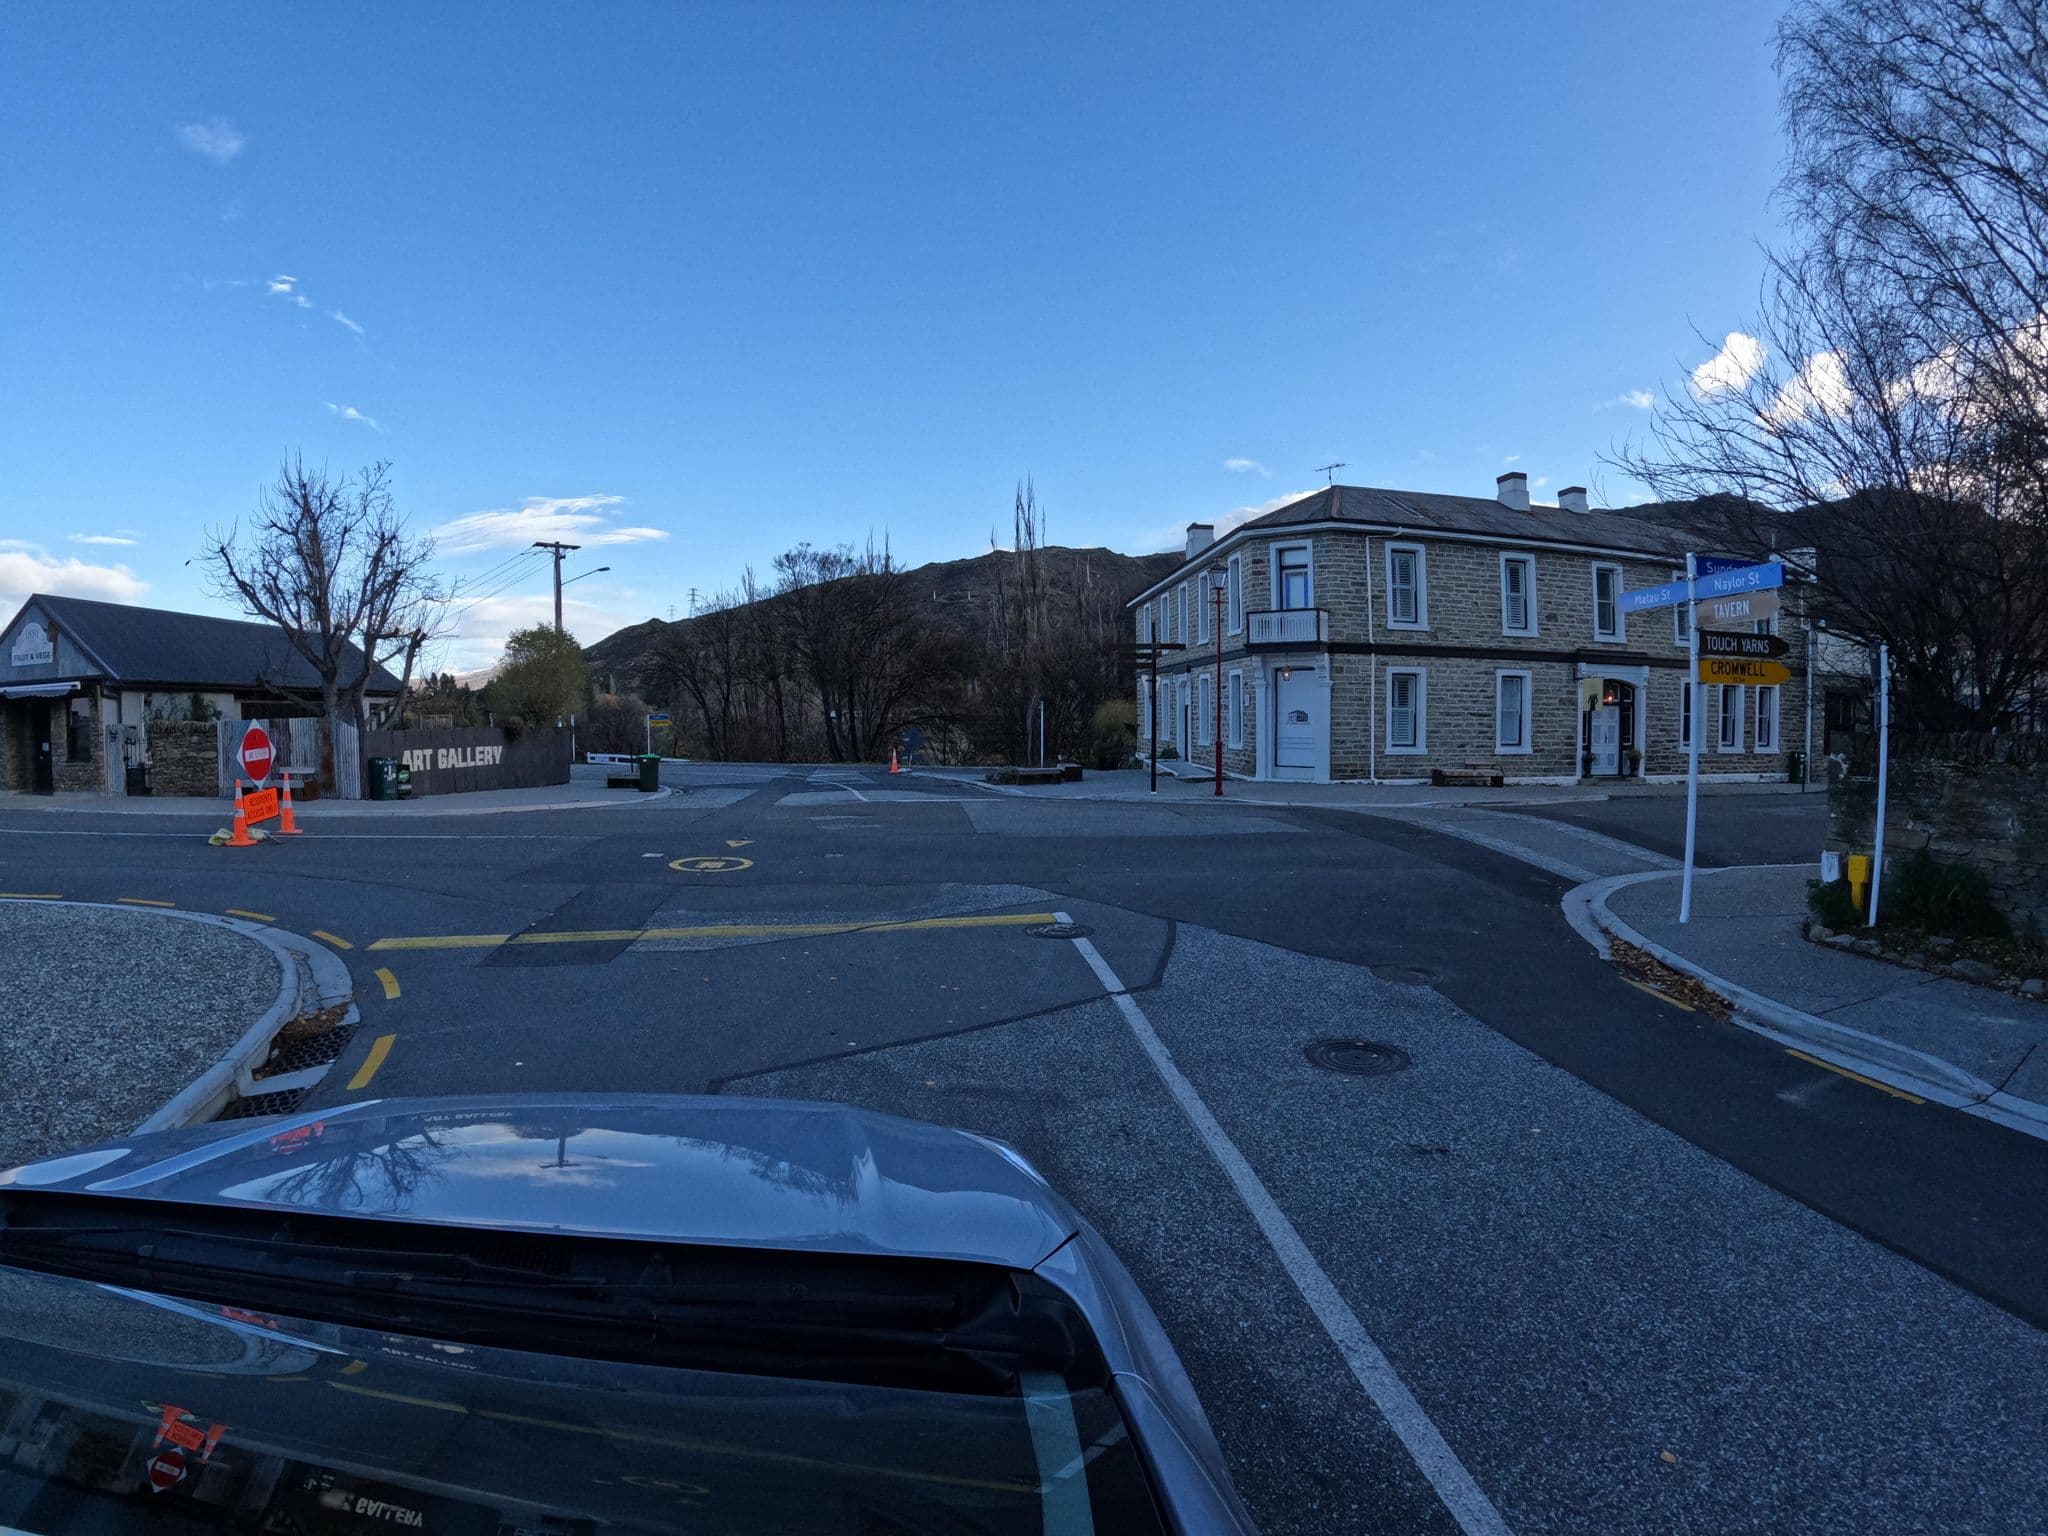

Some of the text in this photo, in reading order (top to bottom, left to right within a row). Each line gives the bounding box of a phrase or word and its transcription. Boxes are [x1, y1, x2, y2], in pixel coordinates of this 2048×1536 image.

[1714, 571, 1760, 592] Naylor St
[1634, 589, 1671, 606] Matau St
[1713, 600, 1750, 619] TAVERN
[1706, 635, 1770, 654] TOUCH YARNS
[36, 651, 50, 660] VEGE
[1711, 661, 1766, 677] CROMWELL
[402, 745, 503, 772] ART GALLERY
